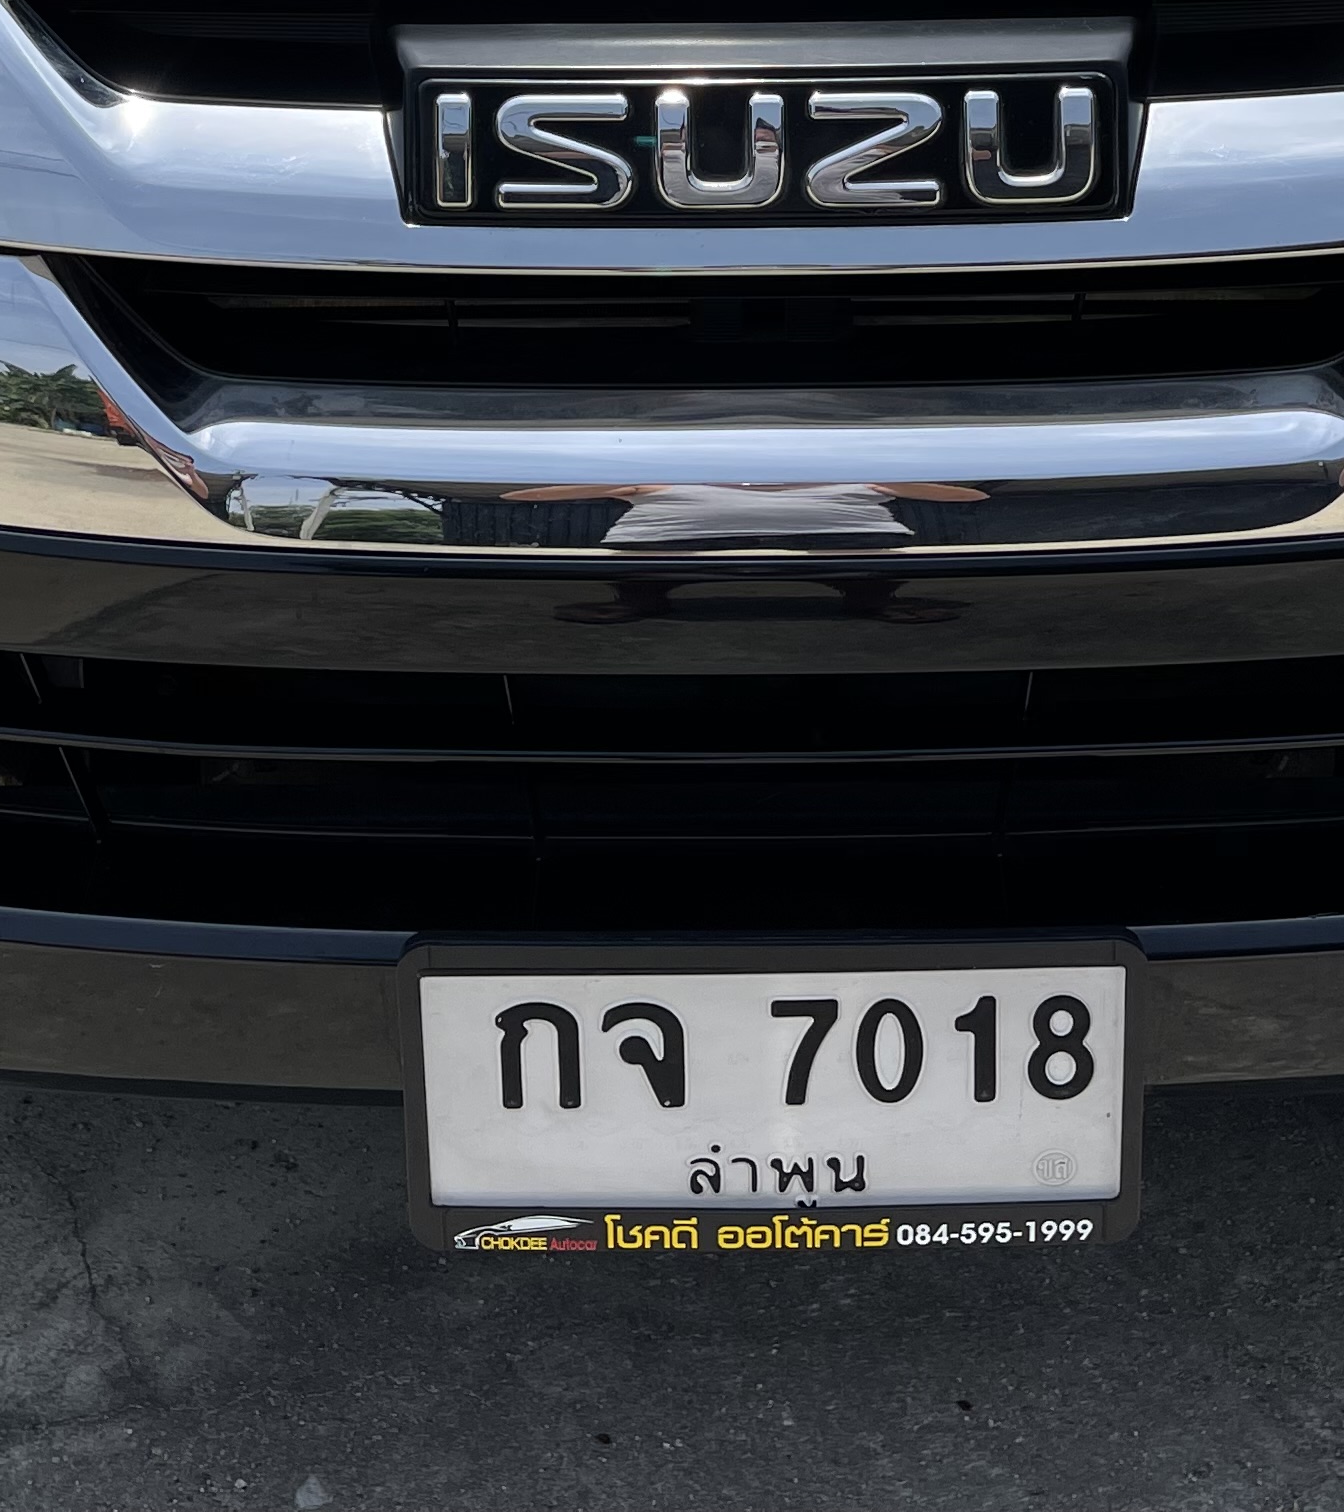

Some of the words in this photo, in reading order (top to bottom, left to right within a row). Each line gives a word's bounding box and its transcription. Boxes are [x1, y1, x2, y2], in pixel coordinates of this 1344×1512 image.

[434, 87, 1100, 210] ISUZU
[494, 1001, 686, 1109] กจ
[769, 994, 1095, 1104] 7018
[689, 1143, 867, 1209] ลำพูน
[481, 1236, 548, 1251] CHOKDEE
[549, 1237, 598, 1251] Autocar
[604, 1214, 699, 1250] โชคดี
[717, 1214, 891, 1250] ออโต้คาร์
[896, 1218, 1094, 1246] 084-595-1999
